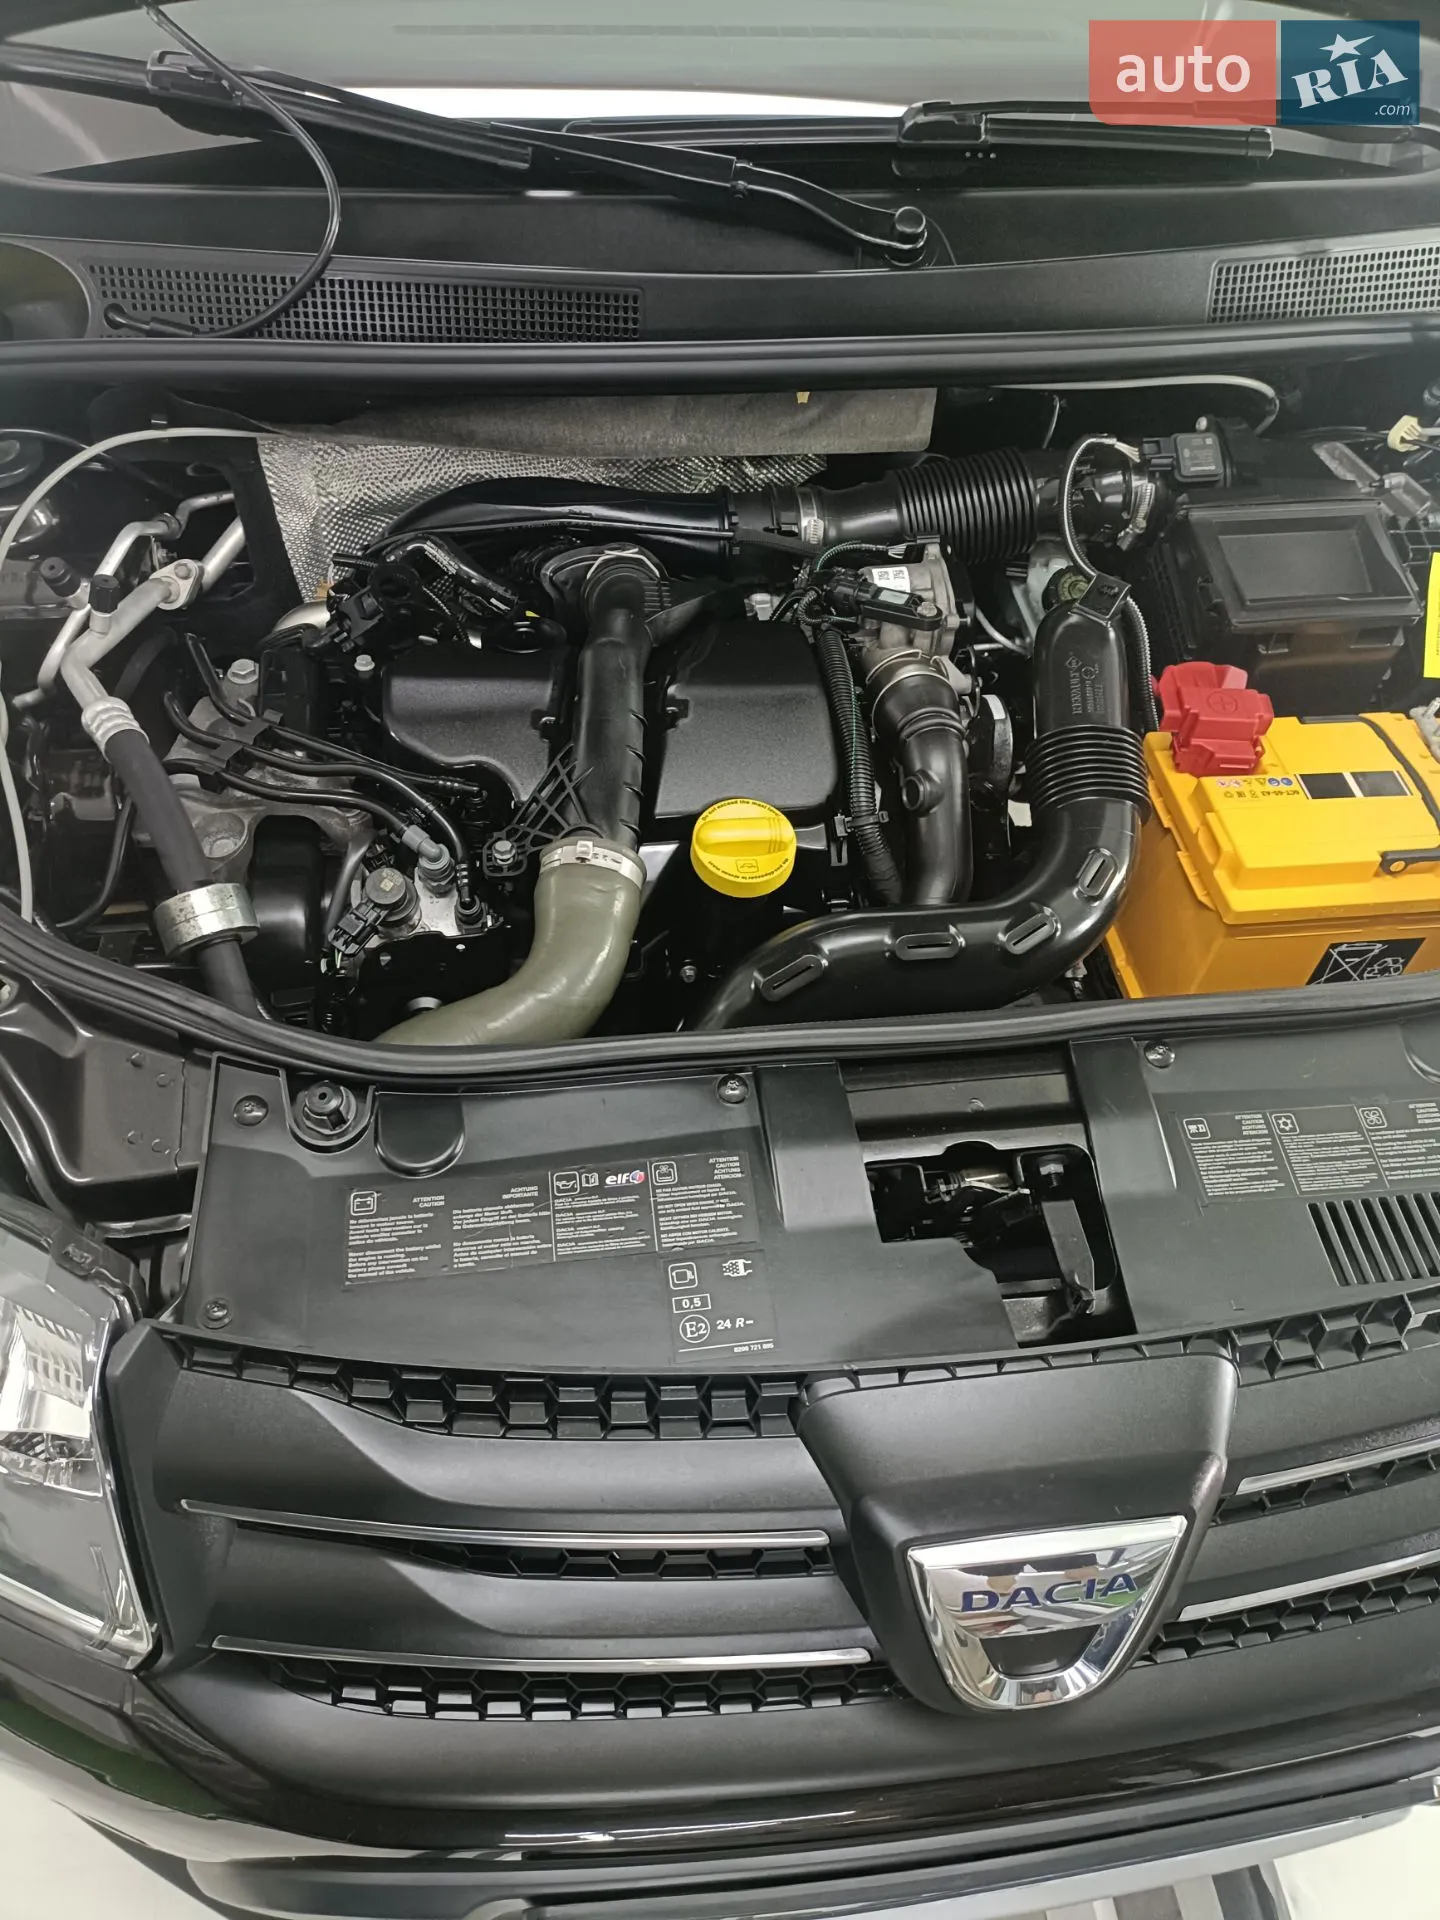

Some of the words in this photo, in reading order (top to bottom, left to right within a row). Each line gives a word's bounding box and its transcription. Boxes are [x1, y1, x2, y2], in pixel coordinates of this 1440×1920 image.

[606, 1172, 630, 1184] elf
[413, 1195, 444, 1203] ATTENTION
[682, 1298, 701, 1309] 0,5
[684, 1321, 707, 1338] E2
[716, 1319, 732, 1330] 24
[960, 1572, 1138, 1612] DACIA
